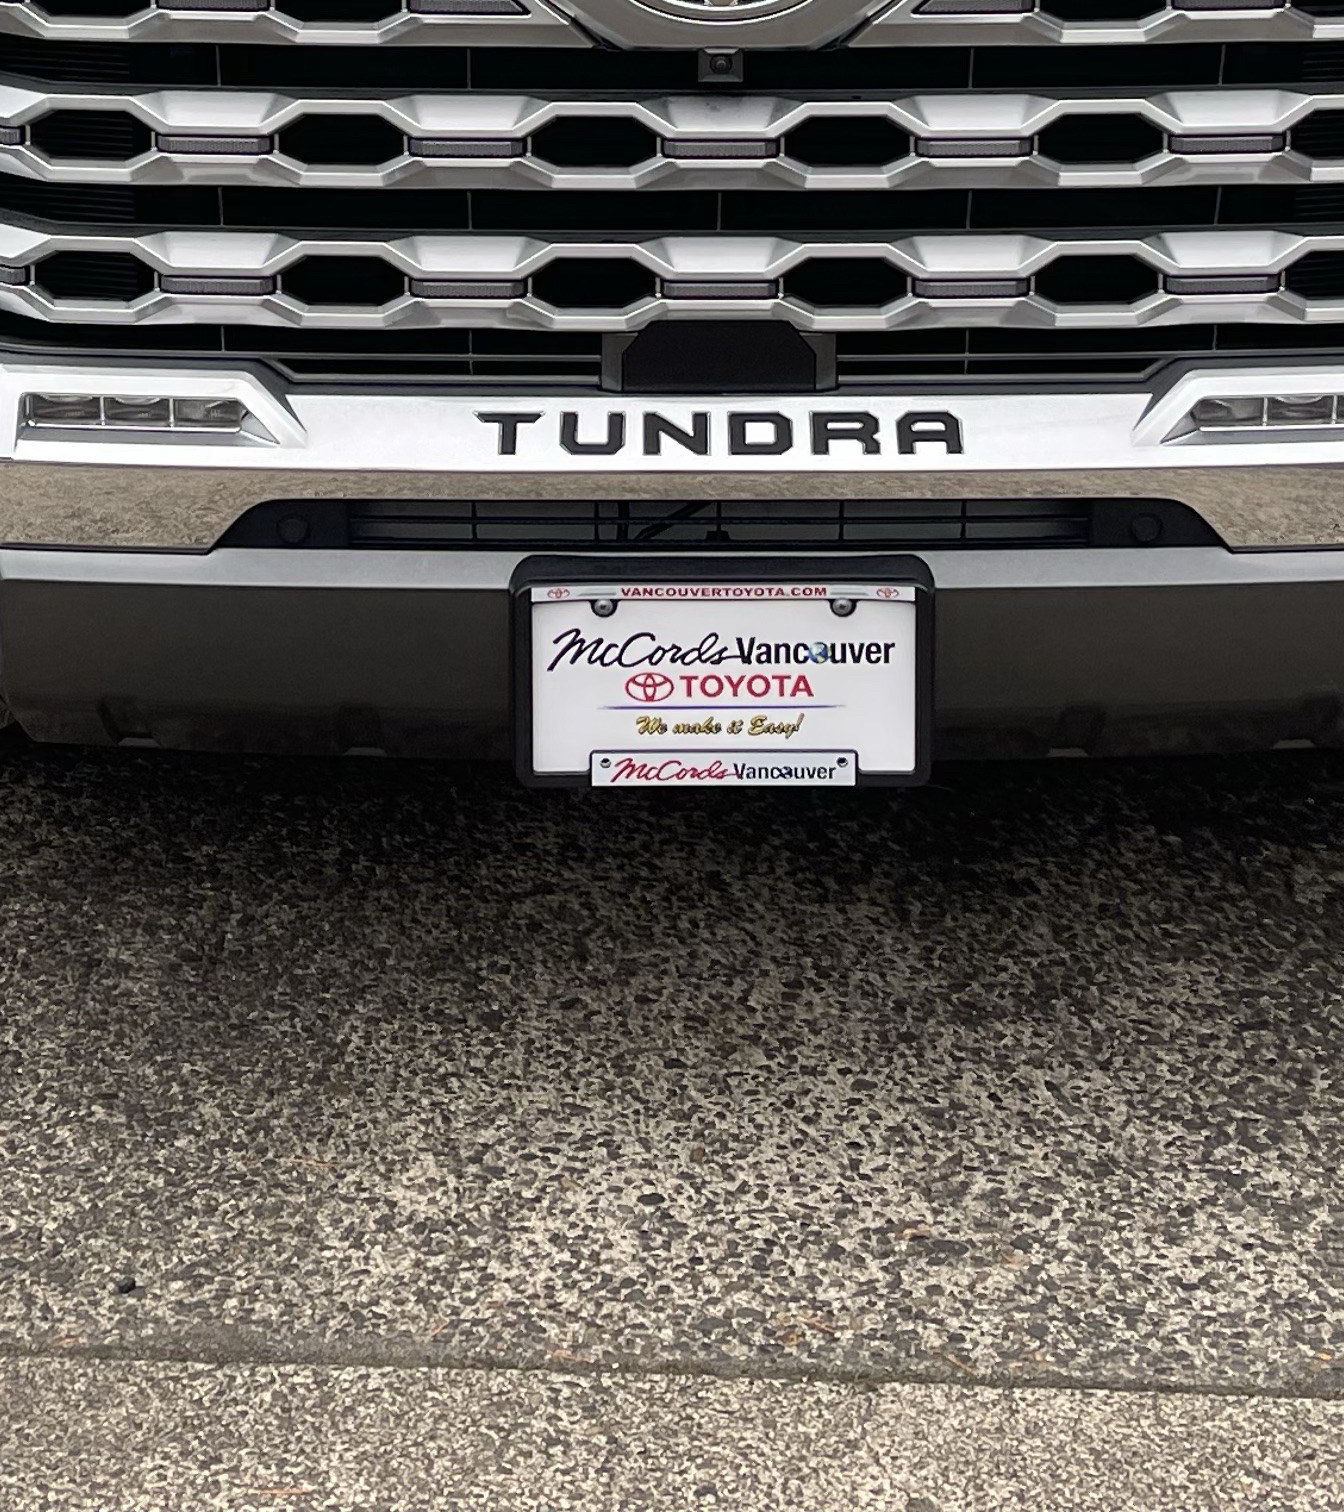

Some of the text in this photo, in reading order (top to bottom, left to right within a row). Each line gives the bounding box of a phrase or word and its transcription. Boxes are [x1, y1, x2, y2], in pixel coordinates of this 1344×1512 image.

[472, 410, 965, 455] TUNDRA
[620, 587, 828, 598] VANCOUVERTOYOTA.COM
[679, 674, 814, 698] TOYOTA
[636, 712, 805, 739] We make it Easy!
